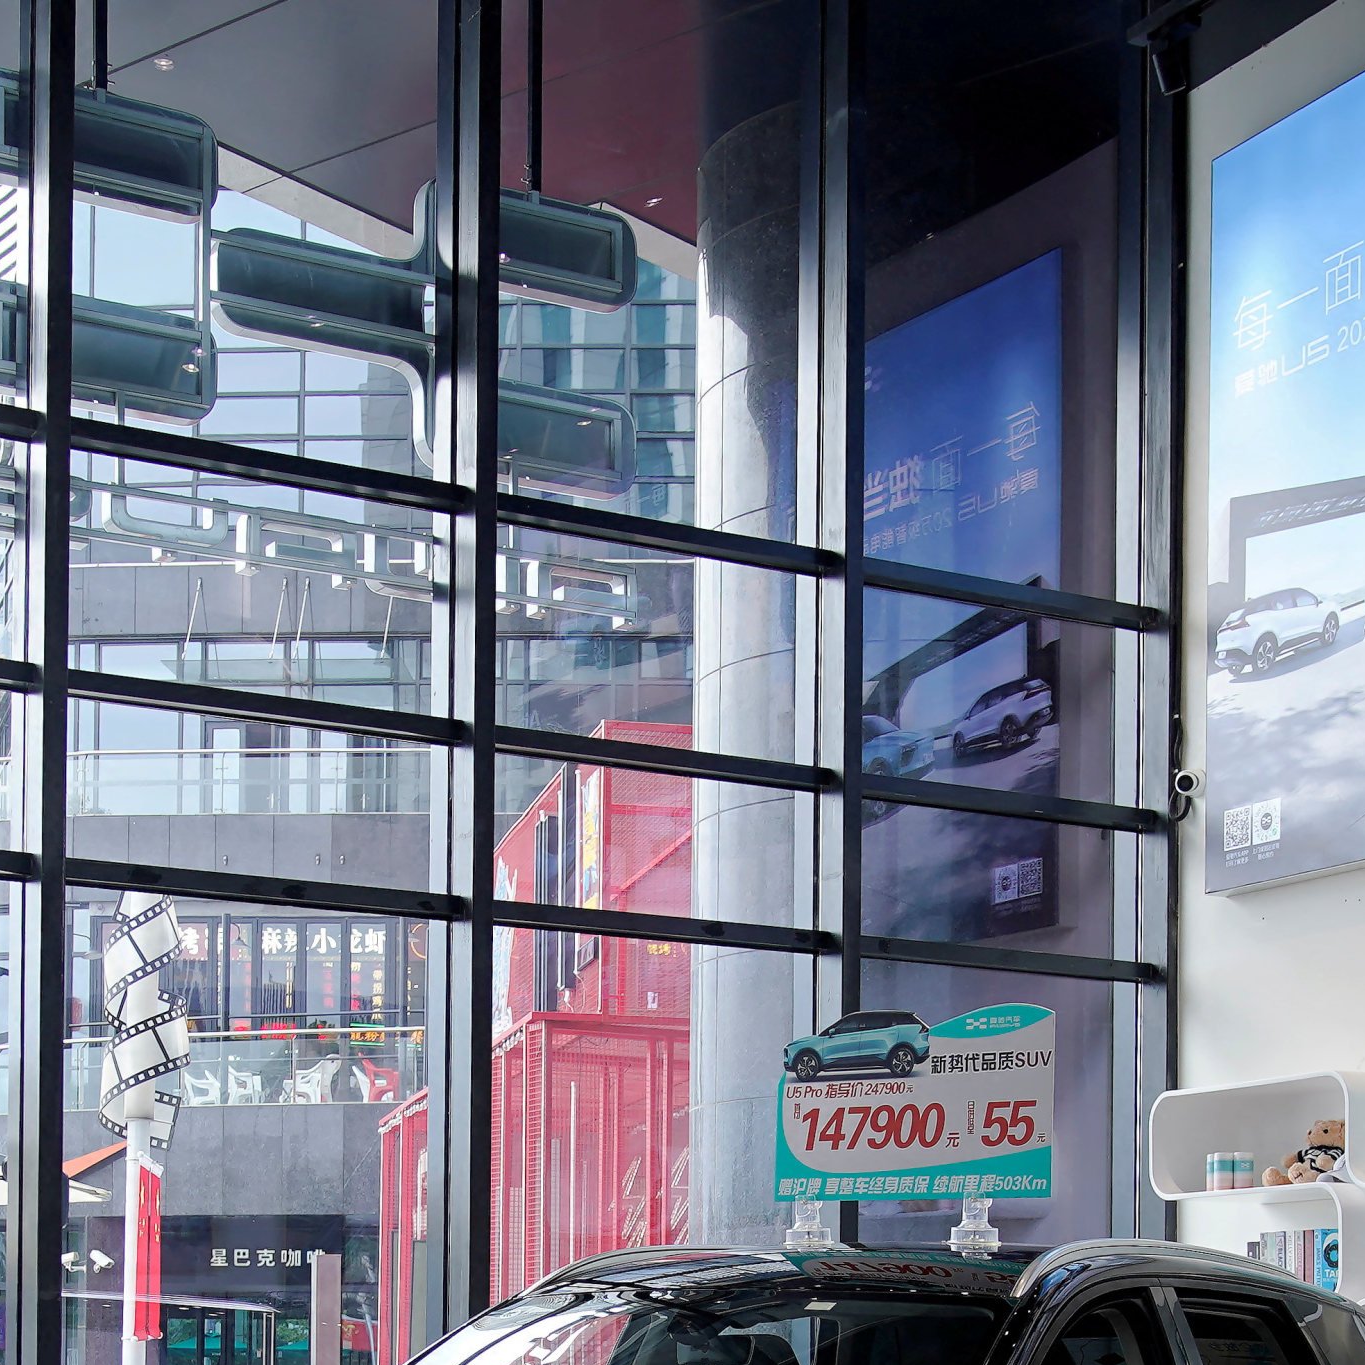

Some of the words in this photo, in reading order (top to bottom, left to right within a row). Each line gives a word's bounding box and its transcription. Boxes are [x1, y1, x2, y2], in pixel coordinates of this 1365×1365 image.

[1233, 240, 1365, 351] 每一面
[930, 1050, 1053, 1075] 新势代品质SUV
[786, 1086, 802, 1099] U5
[804, 1085, 823, 1098] Pro
[980, 1099, 1038, 1147] 55
[777, 1177, 823, 1196] 赠沪牌
[825, 1175, 930, 1196] 享整车终身质保
[932, 1173, 1047, 1195] 续航里程503Km
